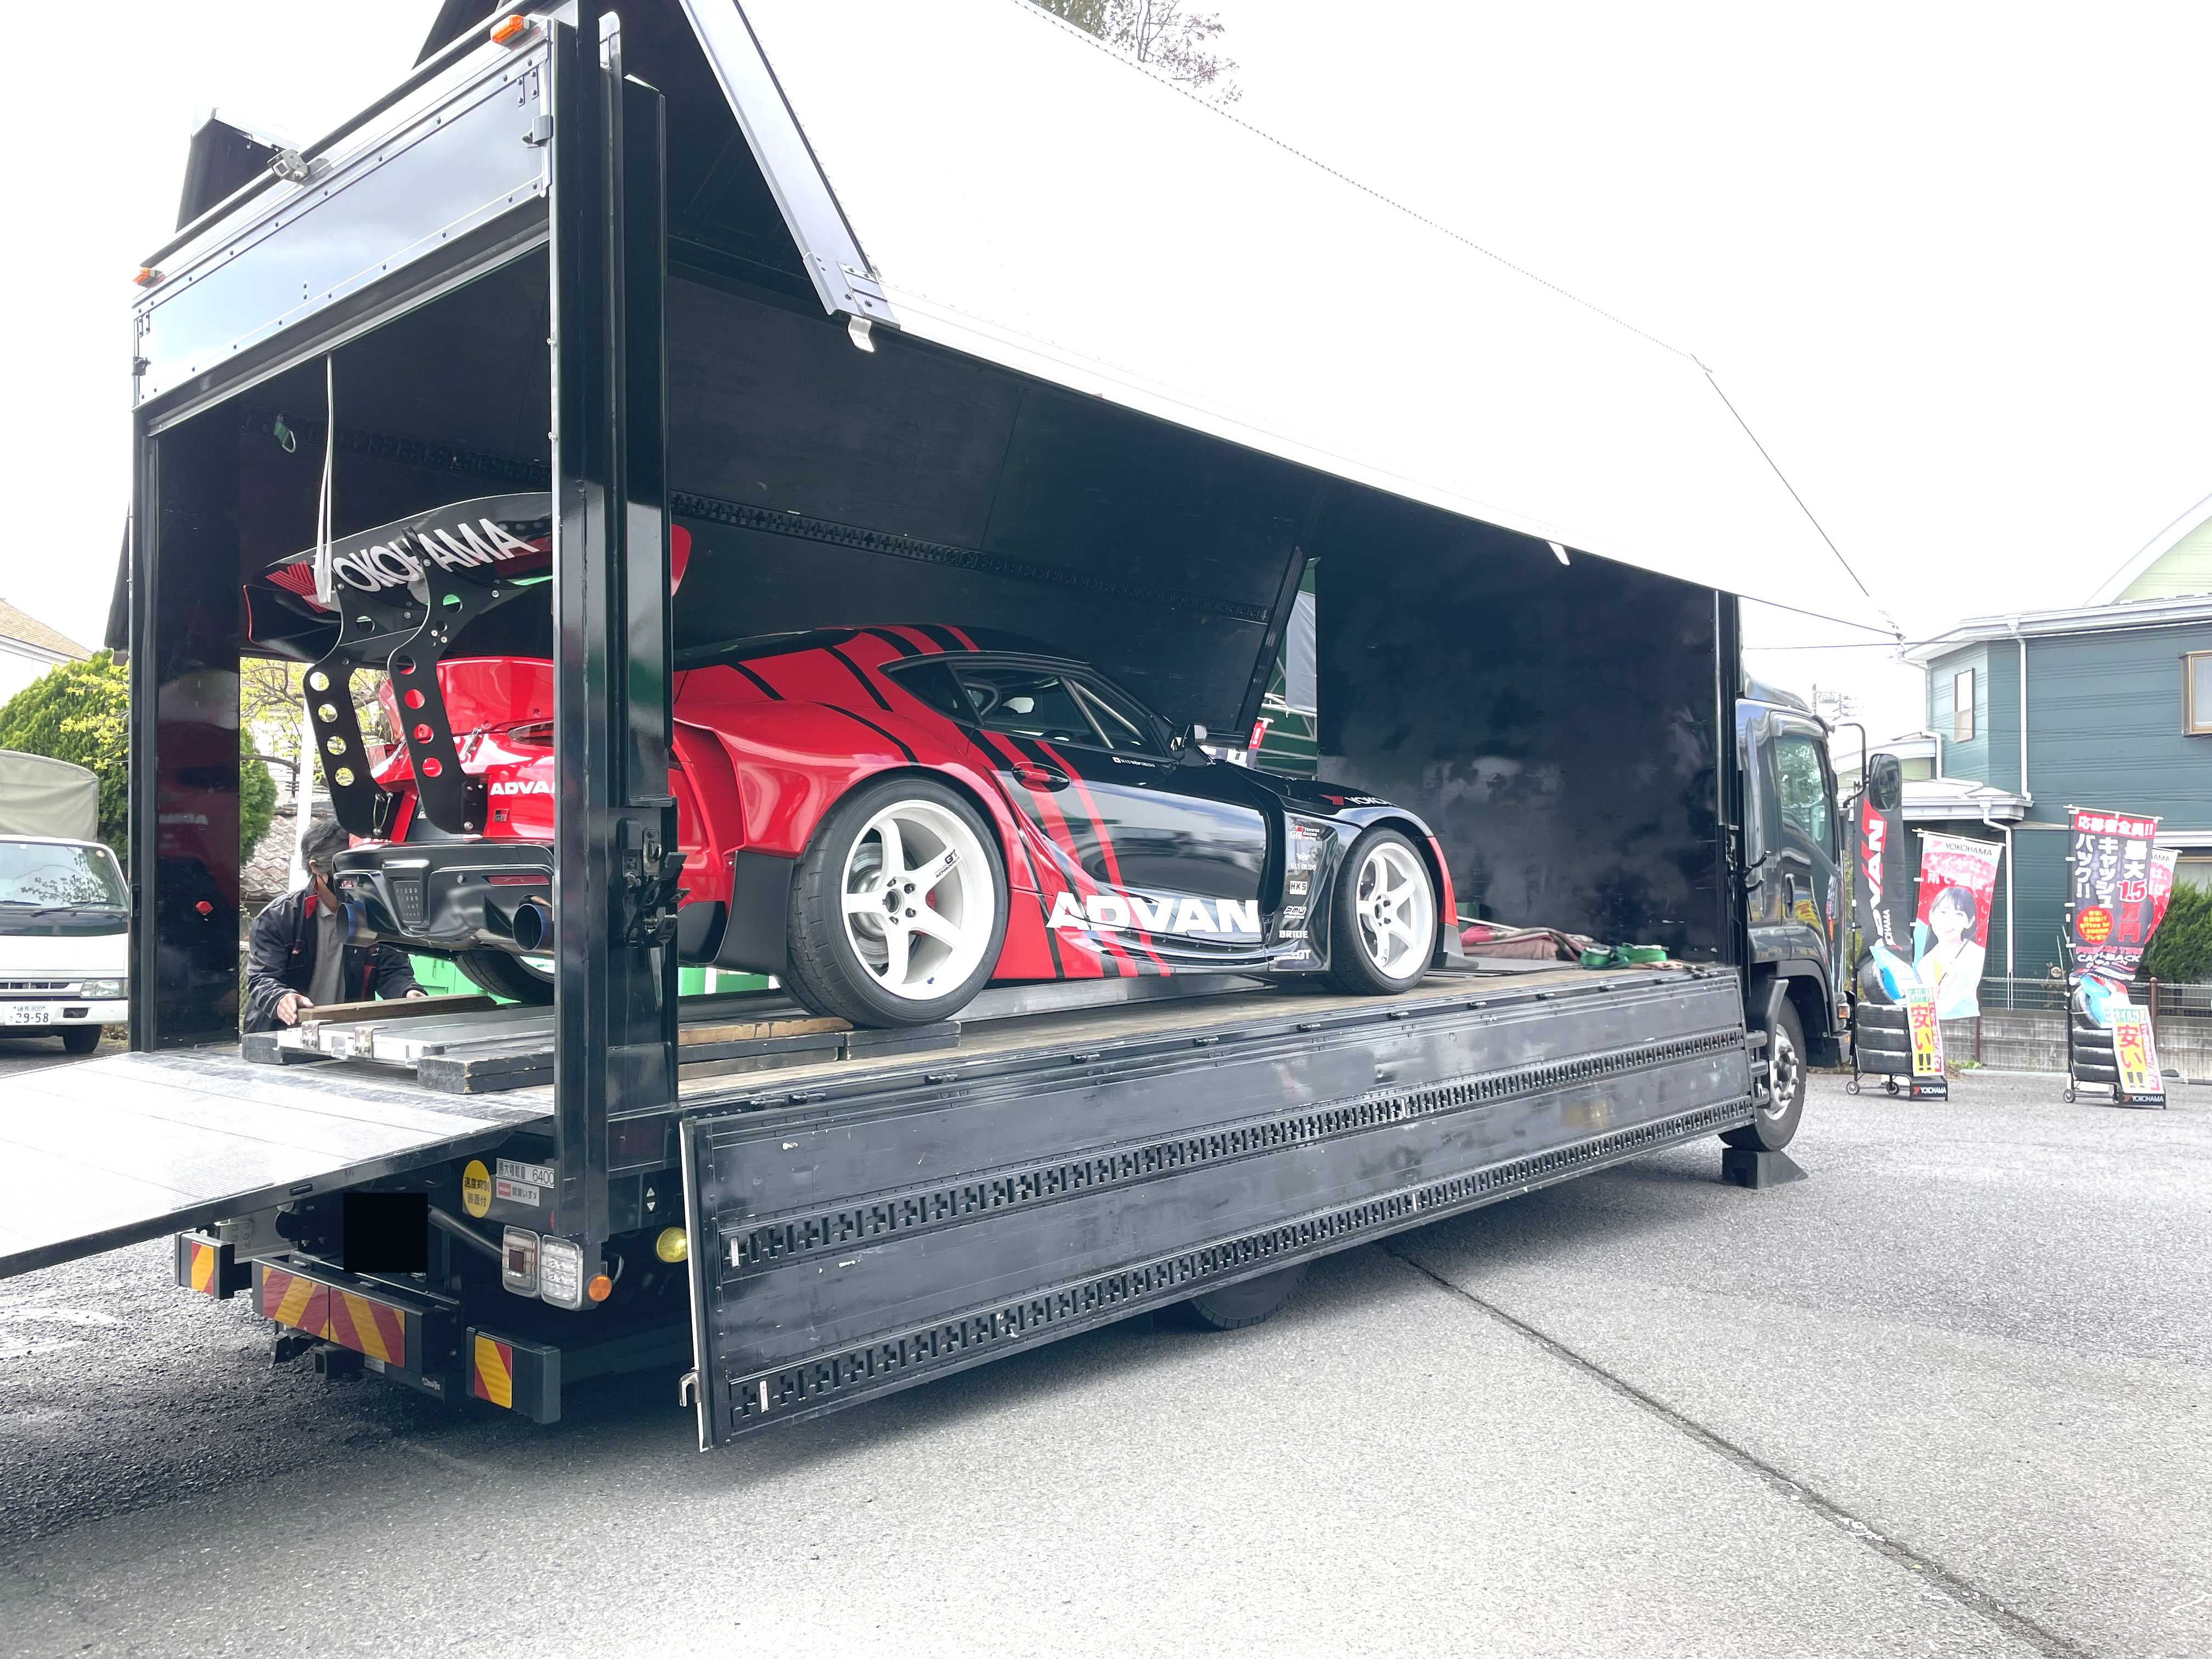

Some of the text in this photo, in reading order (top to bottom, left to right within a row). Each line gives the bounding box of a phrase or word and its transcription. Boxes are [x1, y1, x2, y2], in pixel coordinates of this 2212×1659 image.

[312, 518, 539, 592] OKOHAMA
[945, 849, 957, 864] GT
[1945, 842, 1992, 856] YOKOHAMA
[2075, 833, 2095, 899] バック!!
[2095, 837, 2119, 909] キャッシュ
[1290, 882, 1306, 890] HKS
[1867, 819, 1884, 947] DVAN
[1046, 891, 1261, 933] ADVAN
[1279, 930, 1308, 939] BRIDE
[15, 1013, 49, 1023] 29-58
[1911, 1005, 1931, 1071] 安い!!
[2117, 1025, 2146, 1088] 安い!!
[532, 1169, 554, 1185] 6400
[467, 1192, 487, 1207] 装置付
